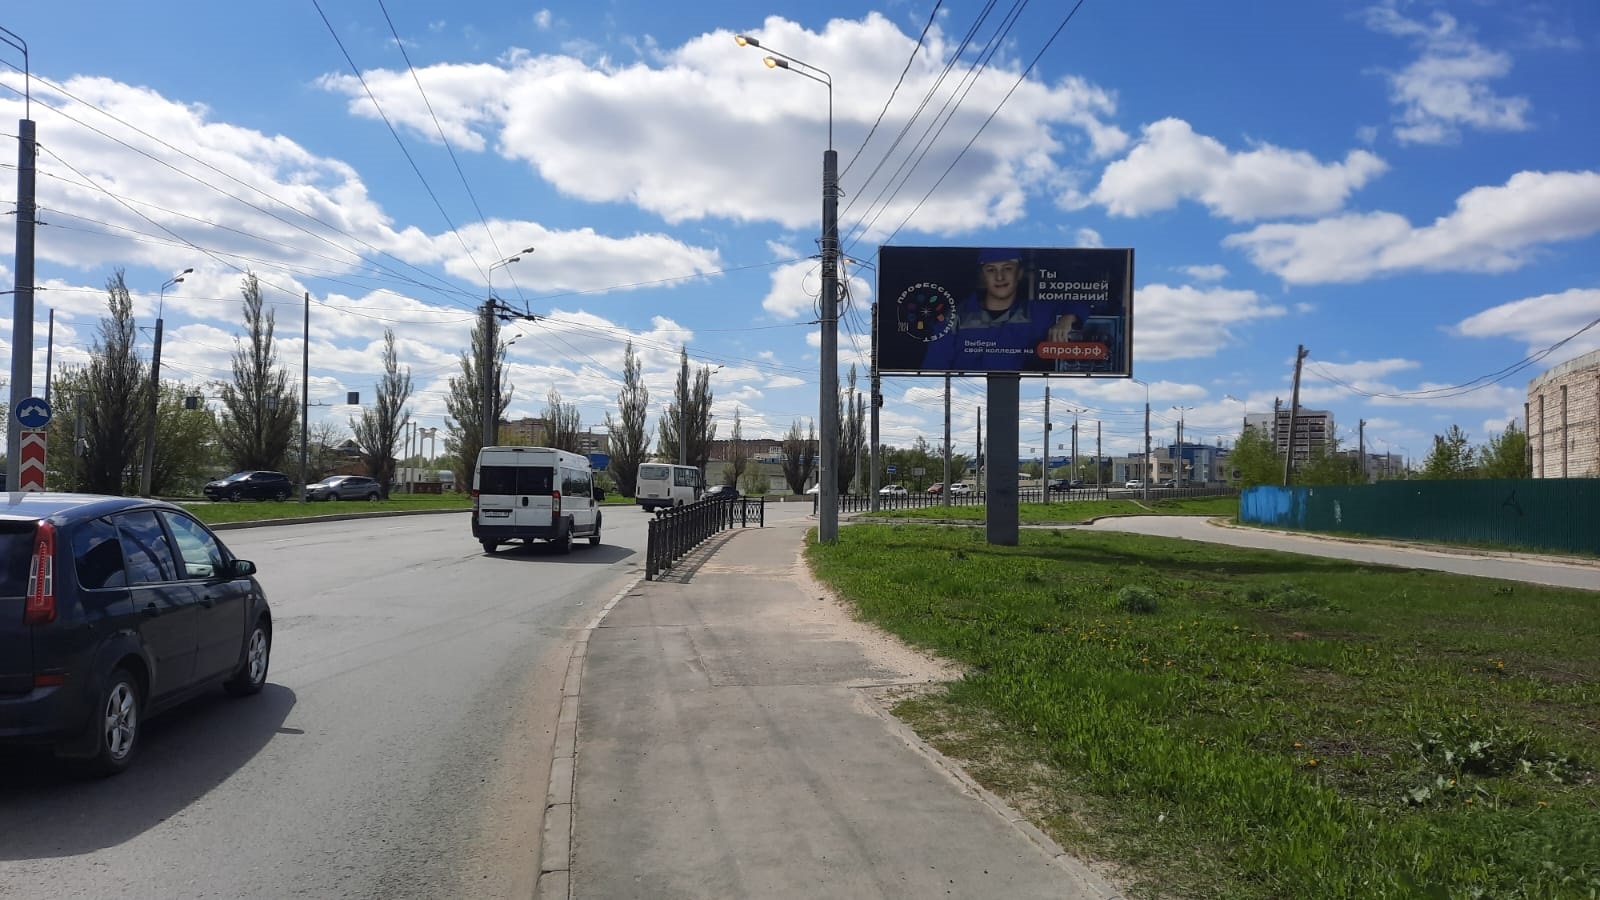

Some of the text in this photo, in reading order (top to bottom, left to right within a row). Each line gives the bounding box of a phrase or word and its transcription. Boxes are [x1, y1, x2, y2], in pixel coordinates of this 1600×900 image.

[1040, 269, 1057, 279] Ты
[1040, 280, 1109, 292] в хорошей
[1039, 292, 1109, 301] компании!
[897, 282, 957, 343] ПРОФЕССИОНАЛИТЕТ
[1042, 346, 1102, 356] япроф.рф
